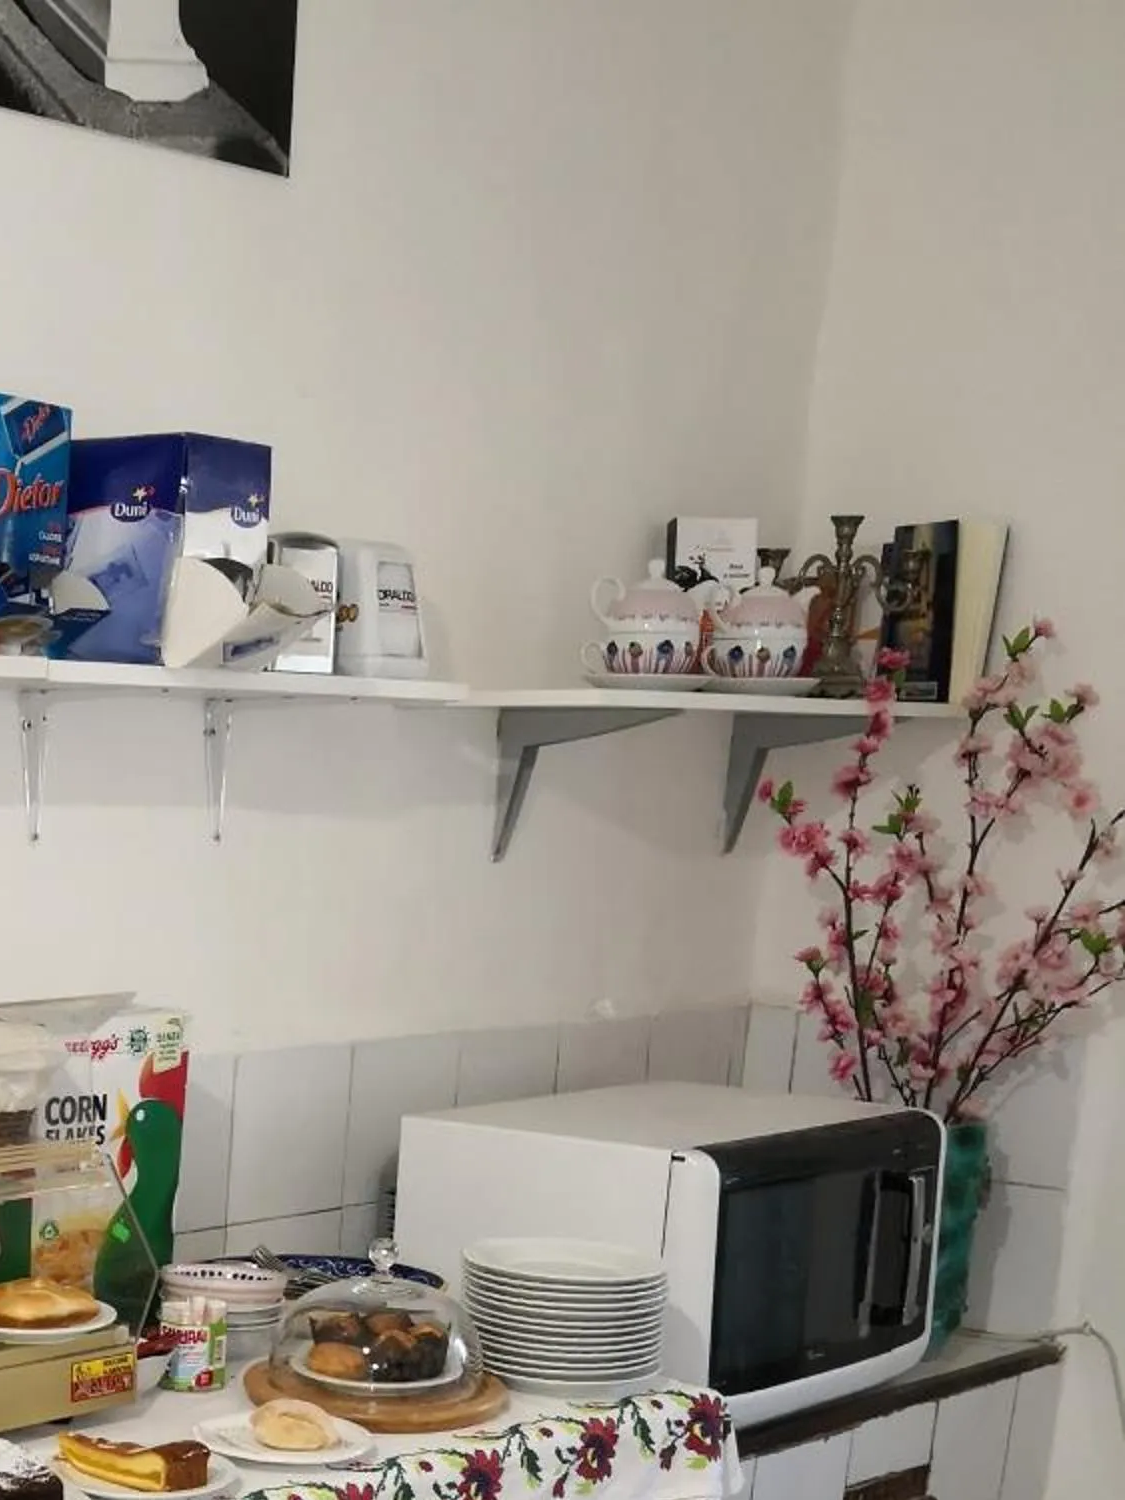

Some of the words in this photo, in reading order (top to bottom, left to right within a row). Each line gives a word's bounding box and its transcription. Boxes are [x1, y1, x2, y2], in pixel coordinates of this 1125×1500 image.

[115, 500, 148, 518] Duni
[233, 506, 260, 522] Duni
[45, 1093, 107, 1126] CORN
